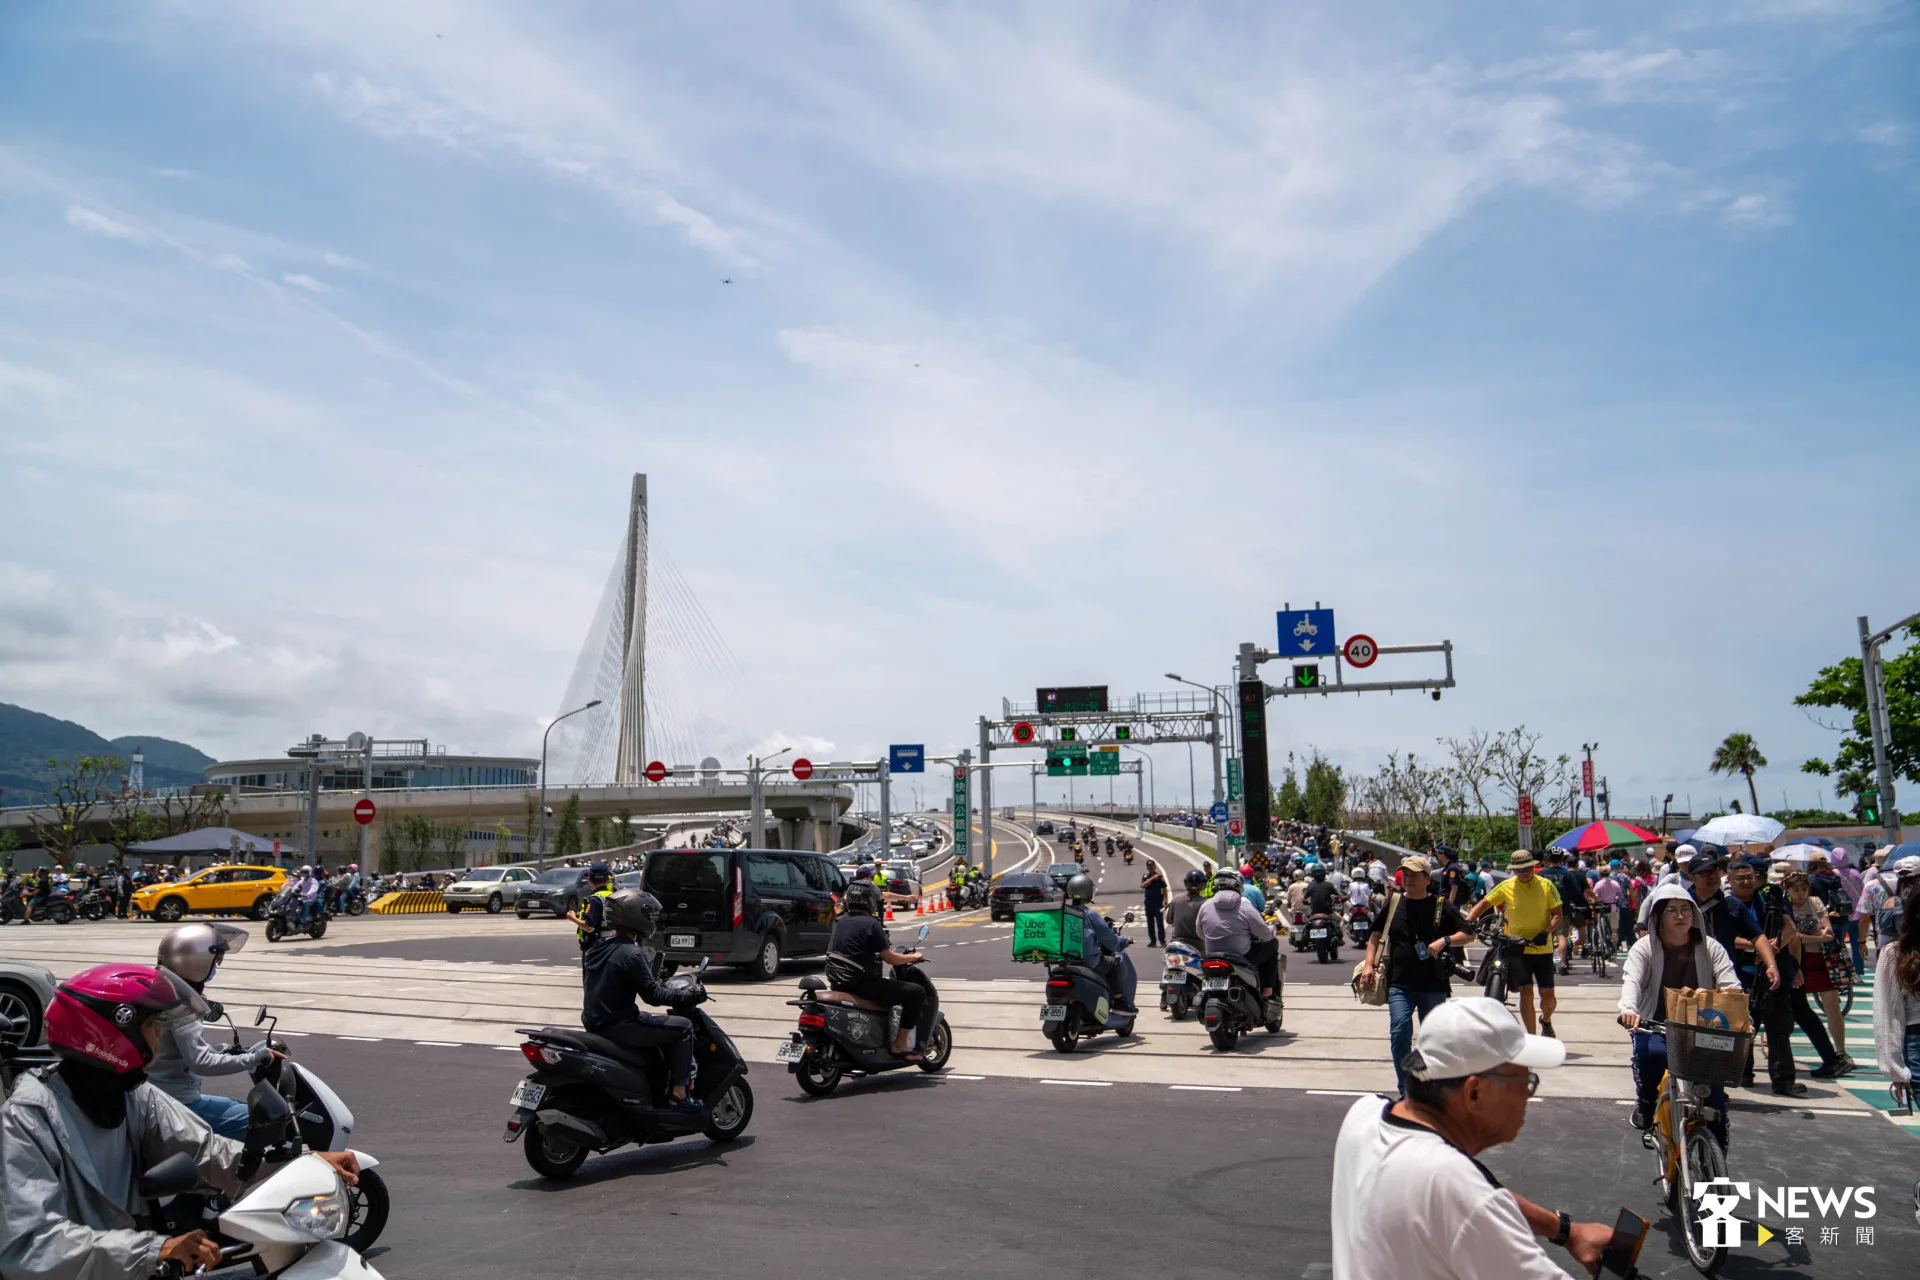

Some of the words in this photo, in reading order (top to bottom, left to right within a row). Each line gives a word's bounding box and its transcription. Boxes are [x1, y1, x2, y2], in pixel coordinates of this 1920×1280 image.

[1351, 645, 1371, 657] 40
[955, 781, 966, 854] 快速公路起點
[1230, 821, 1242, 830] 61
[1024, 920, 1046, 929] Uber
[1024, 929, 1046, 939] Eats
[95, 1047, 129, 1067] foodpanda
